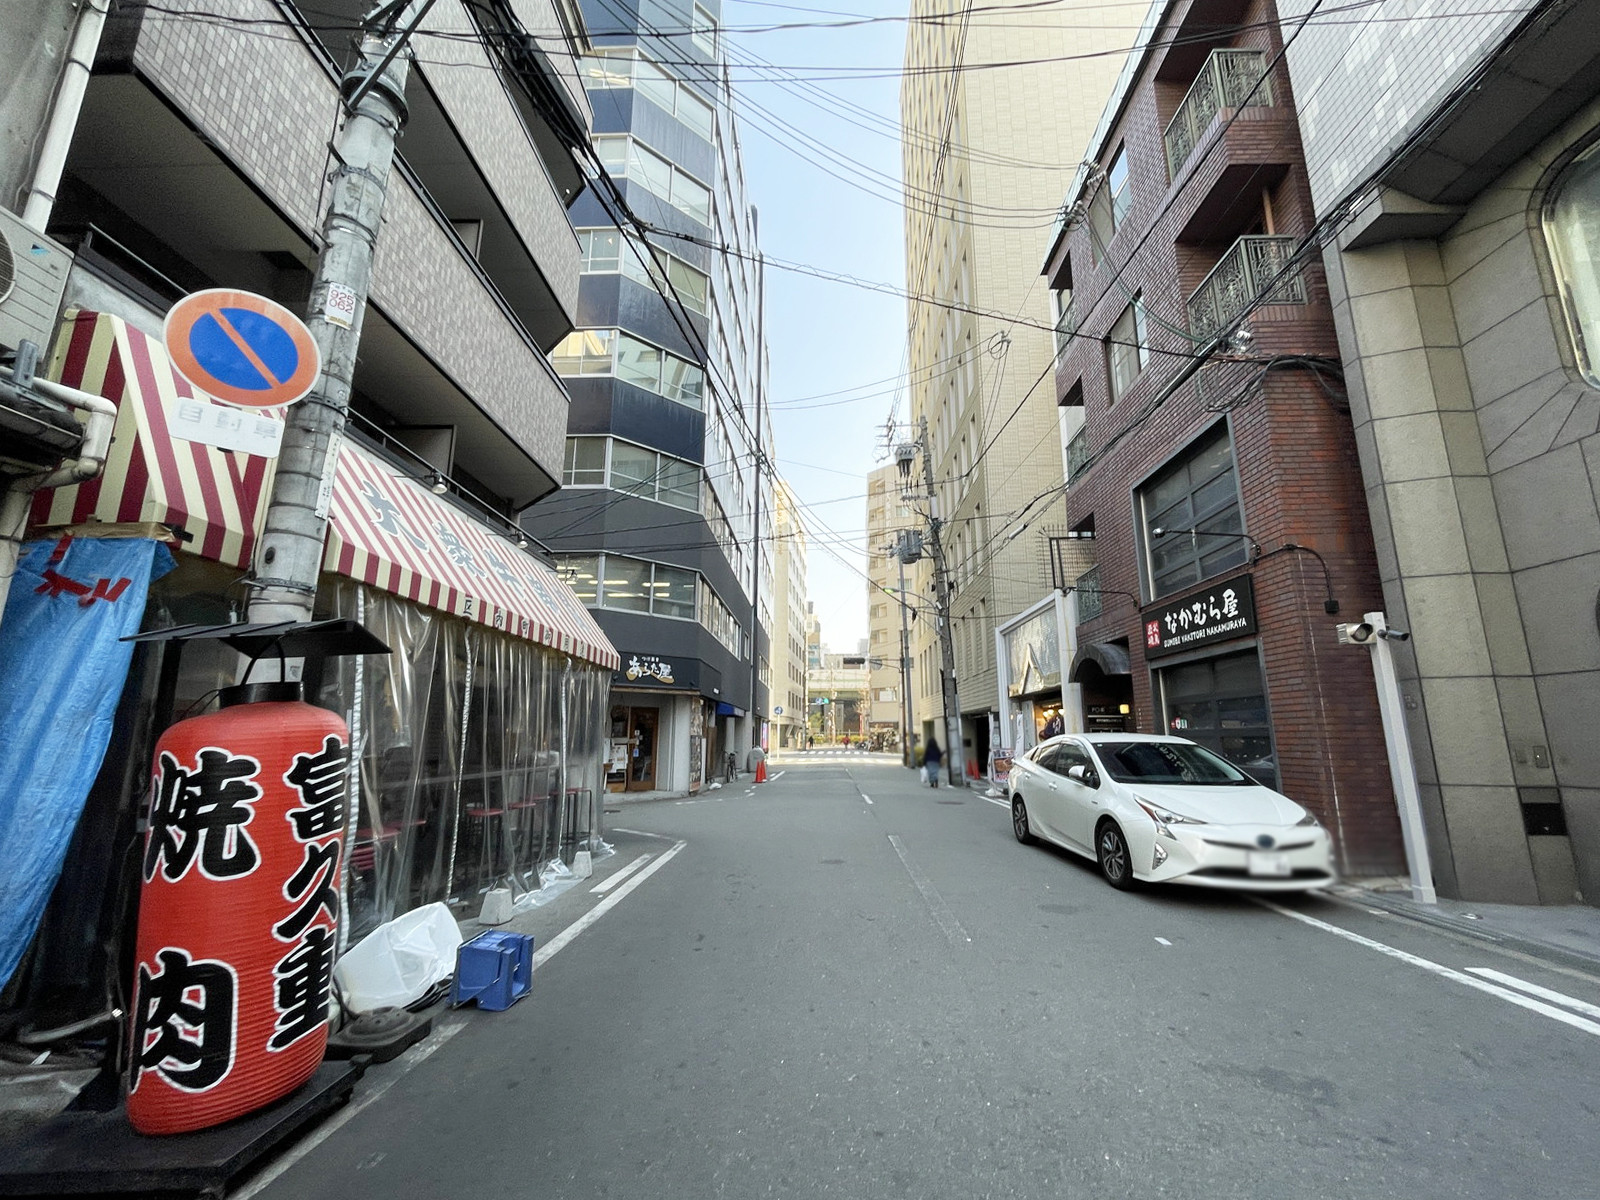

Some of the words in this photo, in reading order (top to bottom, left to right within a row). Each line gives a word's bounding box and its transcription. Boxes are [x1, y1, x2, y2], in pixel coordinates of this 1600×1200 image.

[328, 299, 353, 314] 062
[330, 289, 354, 304] 925
[1164, 588, 1239, 634] なかむら屋
[1181, 629, 1206, 643] YAKITORI
[1206, 617, 1247, 636] NAKAMURAYA
[267, 734, 350, 1052] 富久重
[129, 746, 263, 1093] 焼肉
